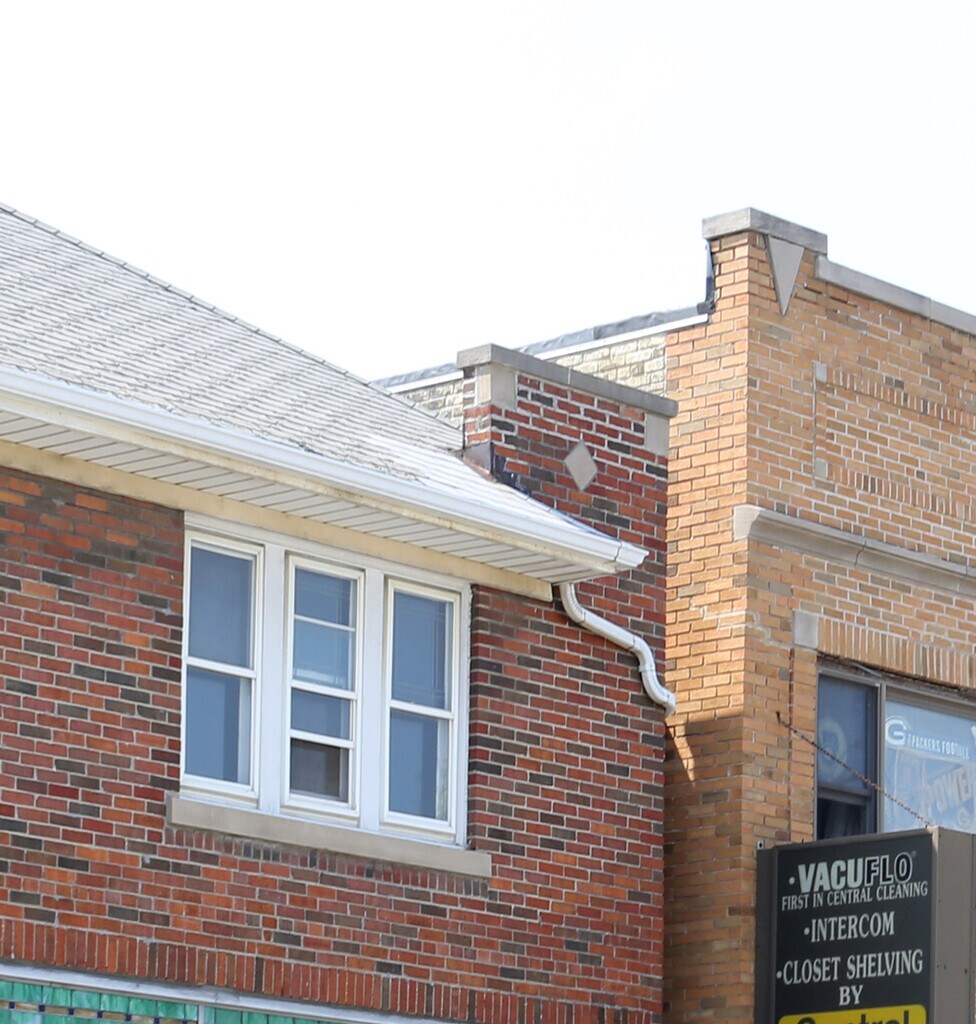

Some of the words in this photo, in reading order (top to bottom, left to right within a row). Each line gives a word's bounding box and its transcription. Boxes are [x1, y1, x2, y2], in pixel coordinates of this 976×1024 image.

[798, 852, 913, 893] VACUFLO
[782, 894, 810, 911] FIRST
[813, 892, 824, 907] IN
[827, 887, 873, 906] CENTRAL
[876, 881, 928, 900] CLEANING
[811, 911, 895, 943] INTERCOM
[783, 956, 841, 985] CLOSET
[846, 949, 923, 980] SHELVING
[839, 985, 863, 1006] BY
